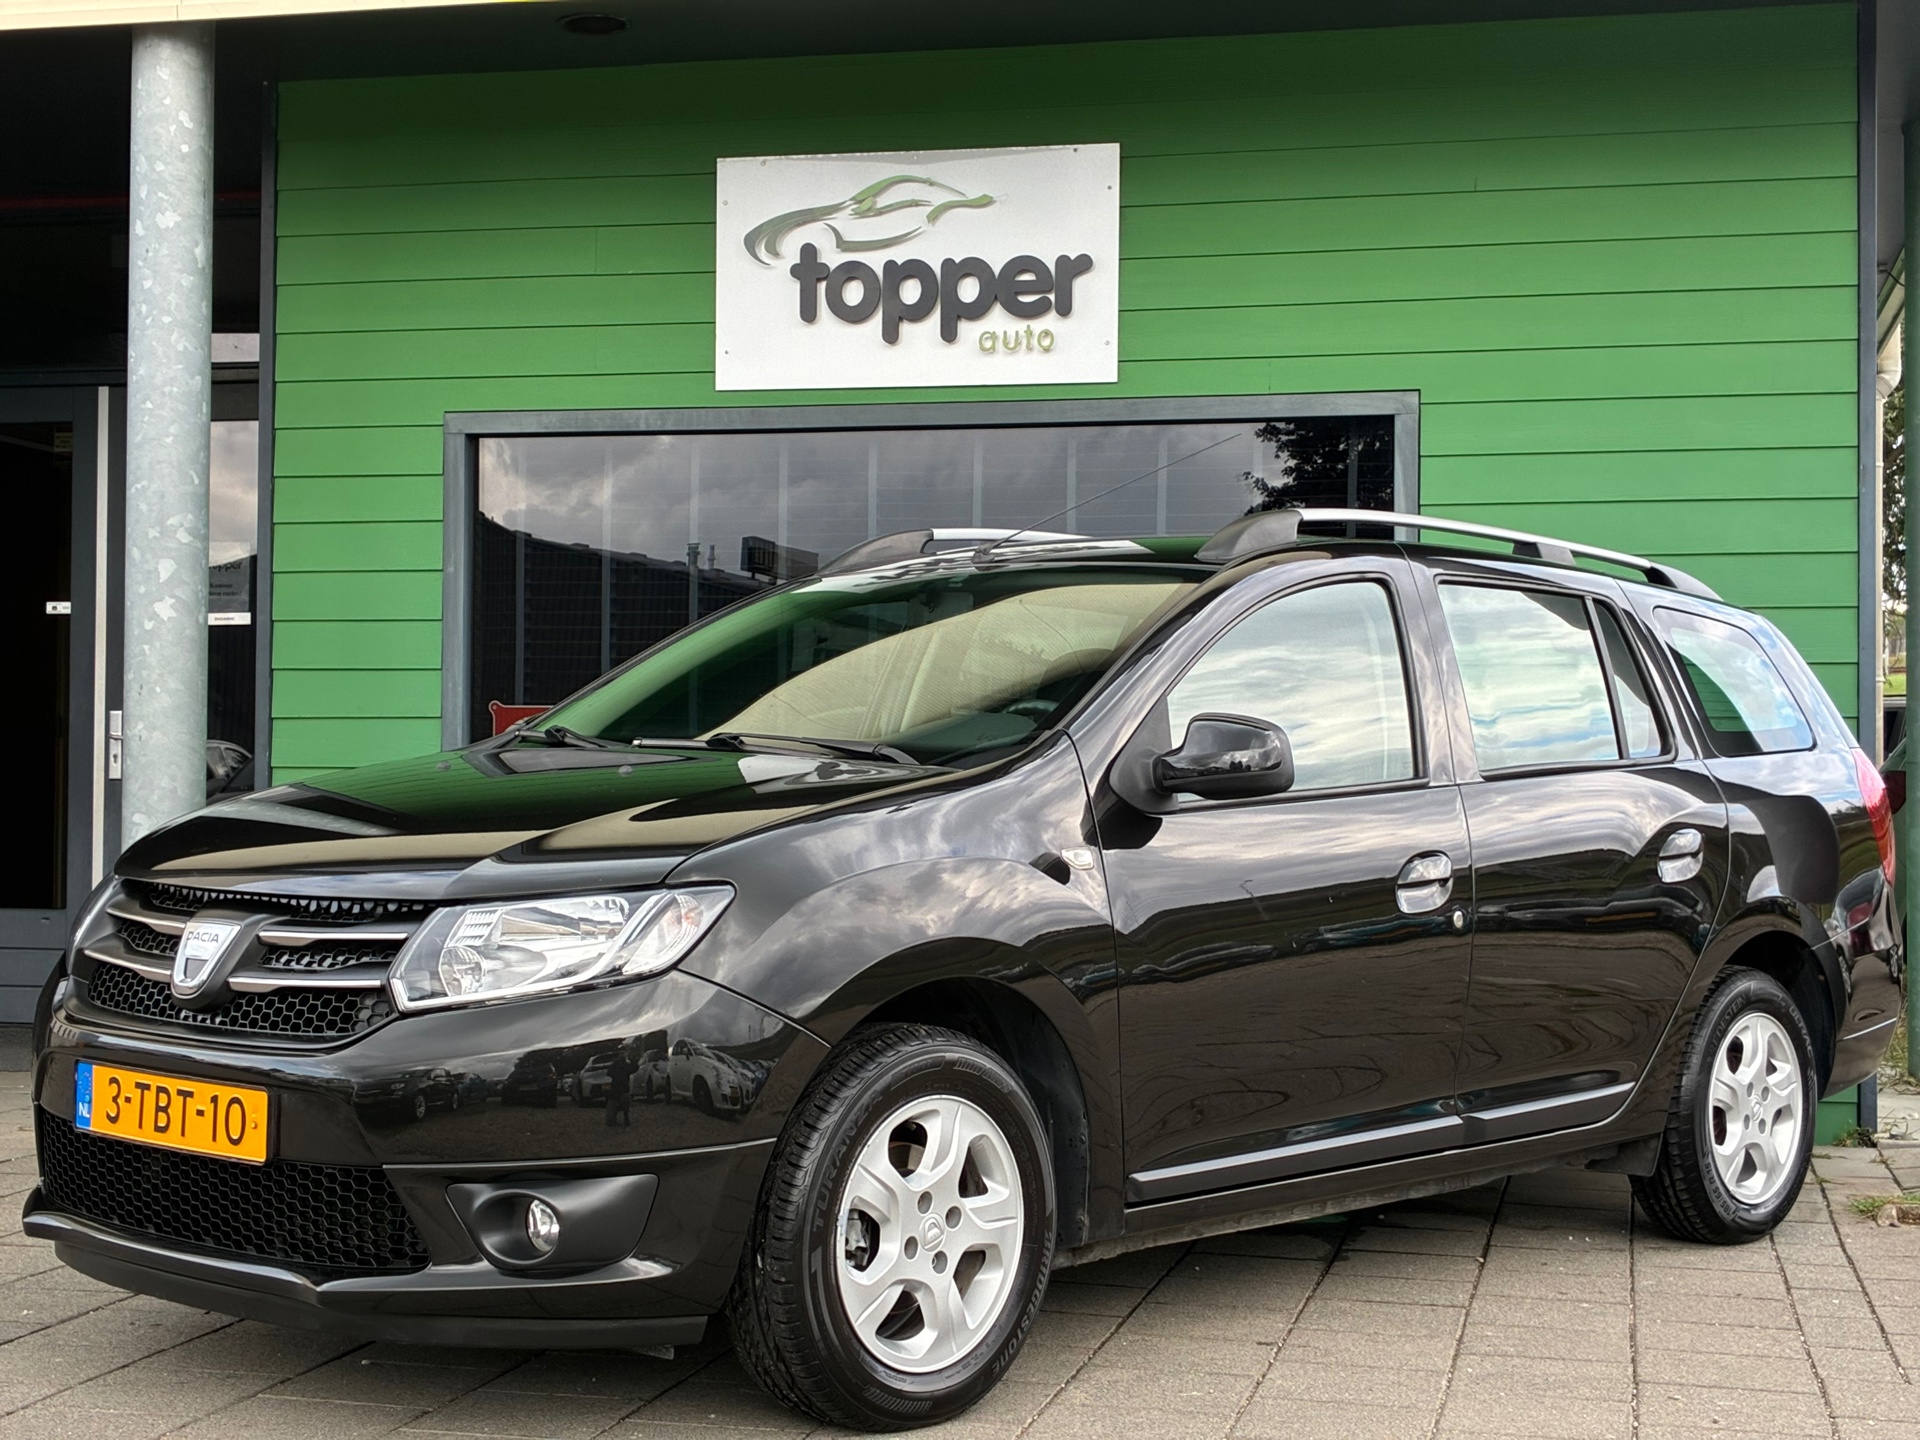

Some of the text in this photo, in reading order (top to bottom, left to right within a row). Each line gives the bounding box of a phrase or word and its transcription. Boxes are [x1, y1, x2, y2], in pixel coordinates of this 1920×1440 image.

[790, 243, 1093, 344] topper
[978, 324, 1055, 352] auto
[186, 931, 219, 943] DACIA
[78, 1103, 90, 1118] NL
[106, 1076, 247, 1146] 3-TBT-10
[813, 1090, 883, 1232] TURANZA
[991, 1231, 1052, 1378] BRIDGESTONE
